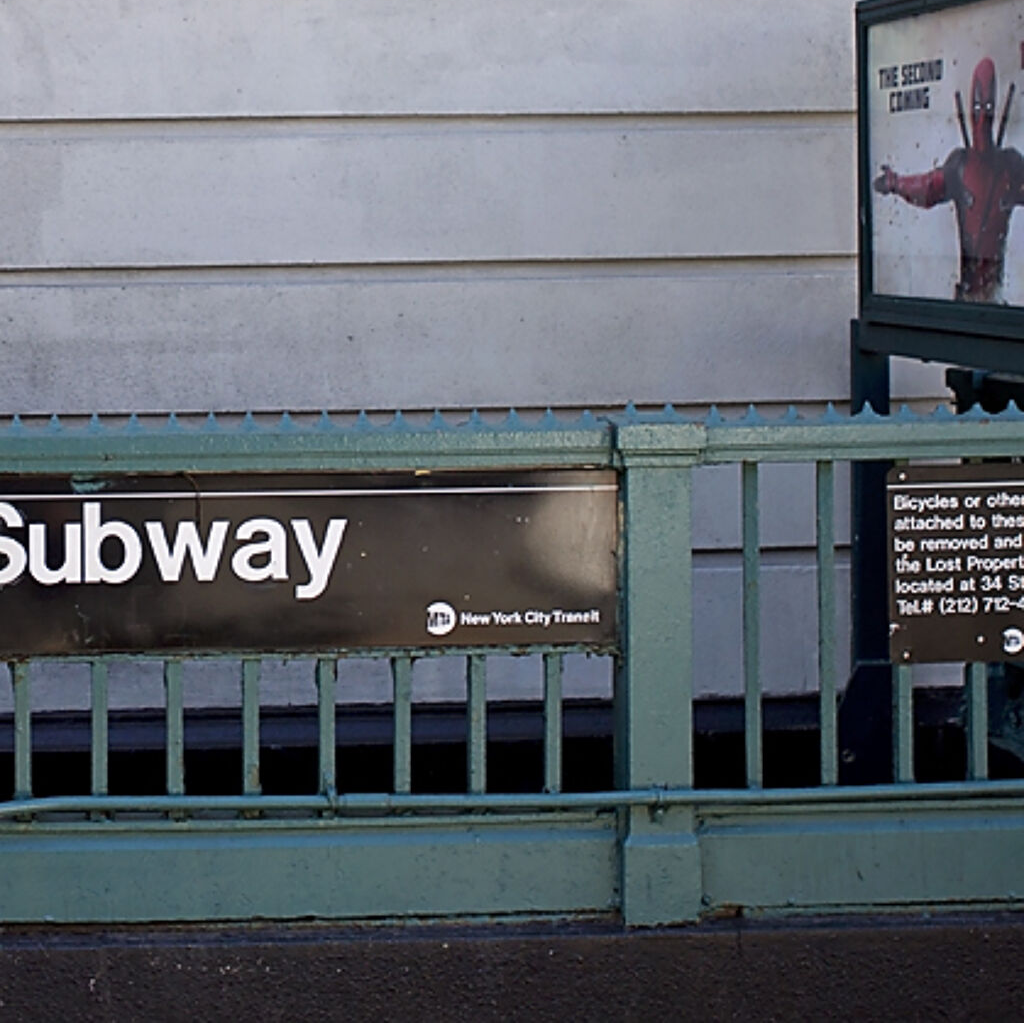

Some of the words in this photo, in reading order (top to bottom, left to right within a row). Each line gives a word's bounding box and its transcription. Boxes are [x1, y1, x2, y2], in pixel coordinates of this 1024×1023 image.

[879, 67, 898, 89] THE
[894, 494, 959, 512] Bicycles
[964, 497, 981, 509] or
[894, 514, 964, 530] attached
[969, 515, 986, 529] to
[894, 538, 915, 552] be
[920, 534, 988, 551] removed
[994, 534, 1023, 549] and
[896, 556, 921, 573] the
[926, 557, 962, 572] Lost
[896, 578, 954, 593] located
[959, 577, 976, 591] at
[981, 576, 1002, 591] 34
[939, 597, 978, 615] (212)
[460, 612, 490, 625] New
[491, 612, 521, 625] York
[525, 611, 551, 626] City
[552, 610, 600, 623] Transit
